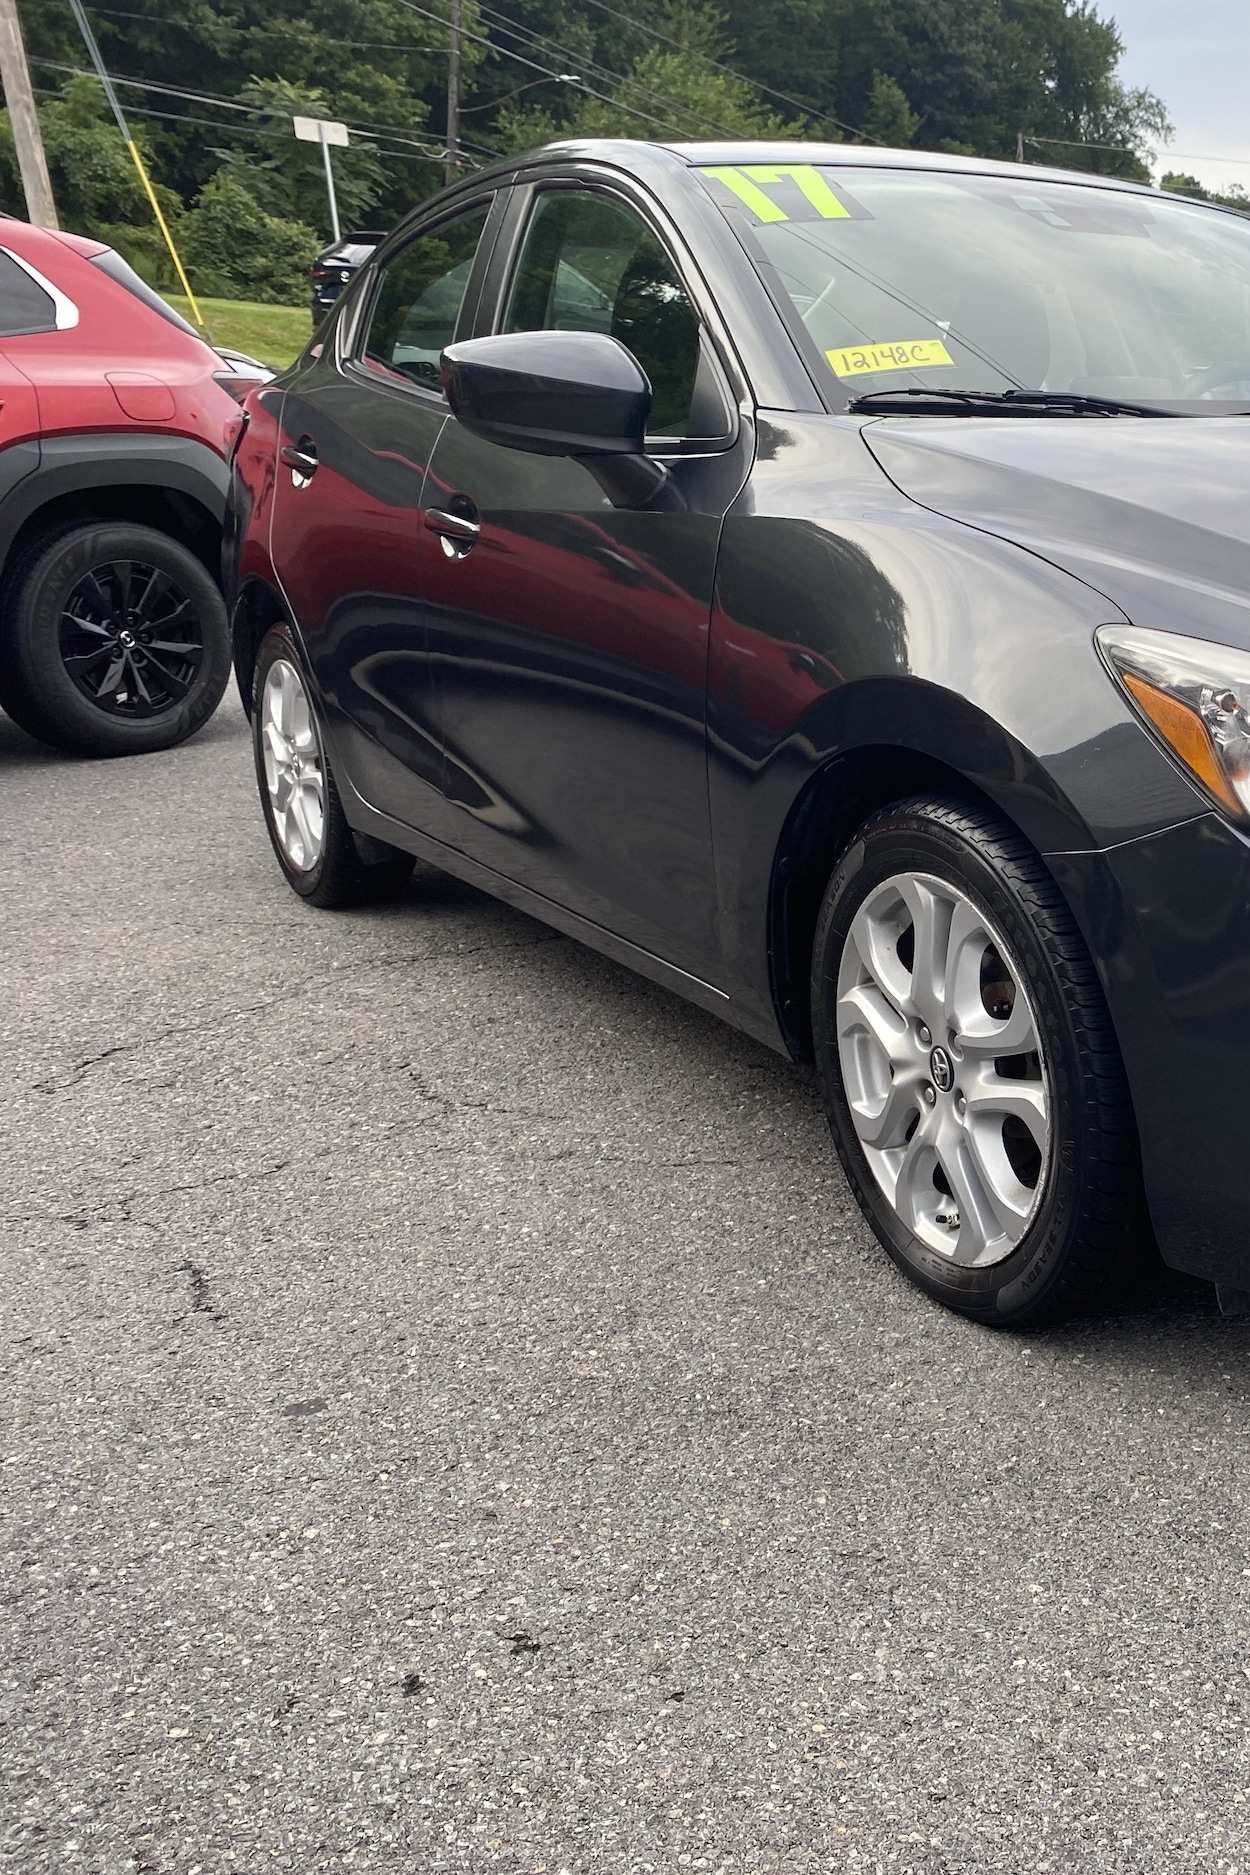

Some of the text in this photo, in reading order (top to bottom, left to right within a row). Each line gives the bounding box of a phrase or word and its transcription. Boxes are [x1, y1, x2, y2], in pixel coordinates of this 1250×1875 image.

[700, 165, 851, 222] 17
[841, 345, 930, 371] 12148C
[1021, 1230, 1057, 1293] SEASON
